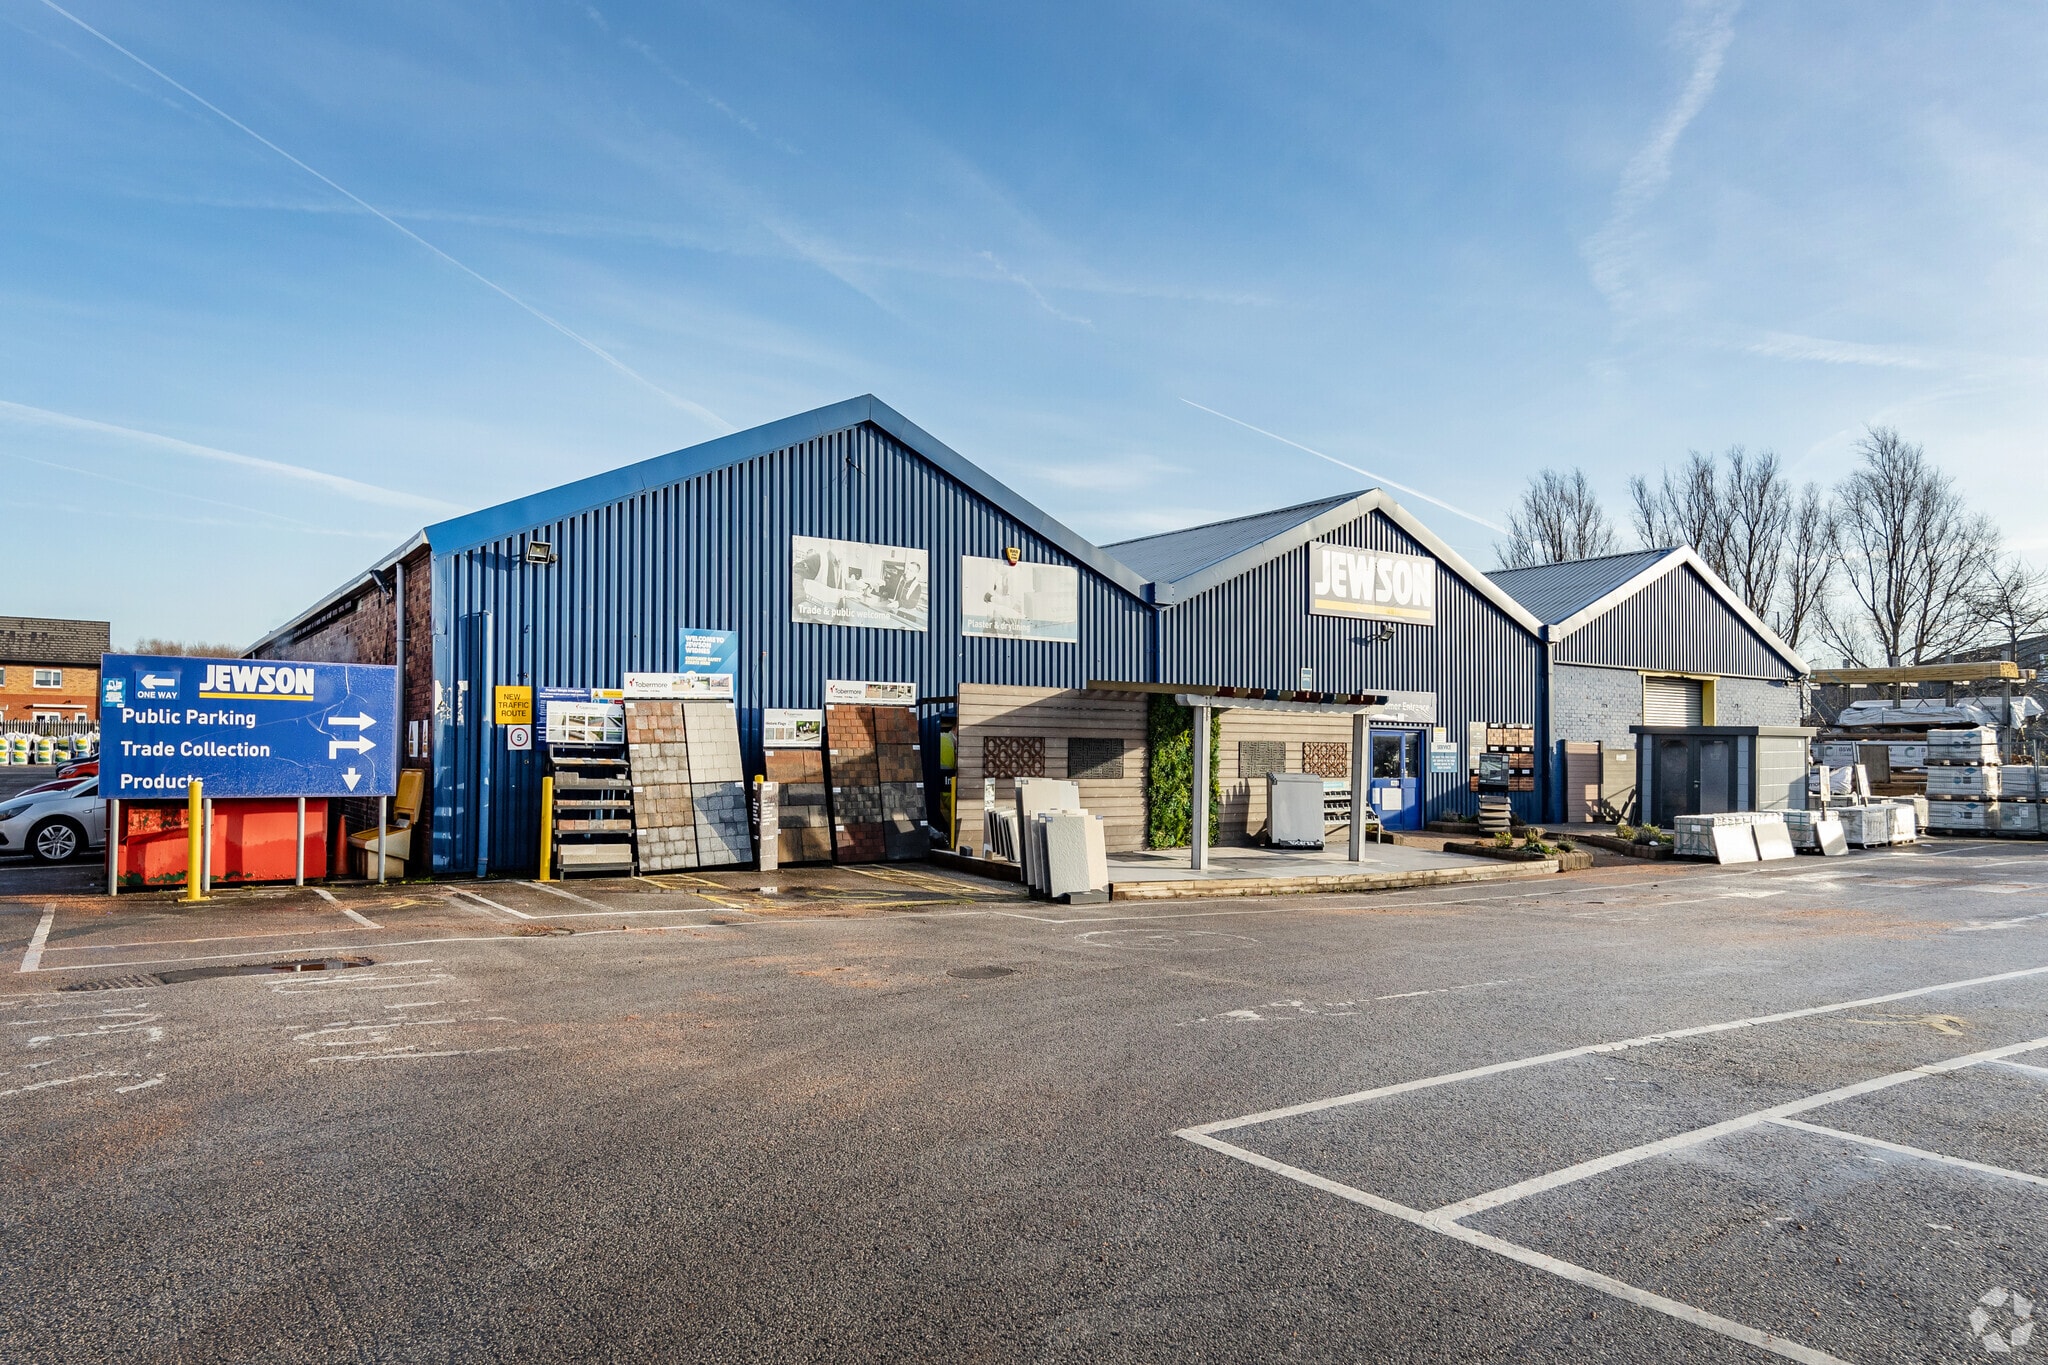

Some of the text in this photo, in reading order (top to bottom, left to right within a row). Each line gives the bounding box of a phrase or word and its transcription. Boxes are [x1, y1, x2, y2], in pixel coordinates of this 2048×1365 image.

[1315, 550, 1431, 607] JEWSON
[798, 604, 890, 619] Trade & public welcome
[968, 620, 992, 629] Plaster
[1000, 621, 1030, 632] drylining
[685, 635, 716, 643] WELCOME
[199, 664, 315, 694] JEWSON
[137, 691, 177, 699] ONE WAY
[835, 687, 862, 695] Tobermore
[122, 708, 256, 728] Public Parking
[501, 709, 527, 717] ROUTE
[516, 733, 522, 741] 5
[120, 740, 270, 757] Trade Collection
